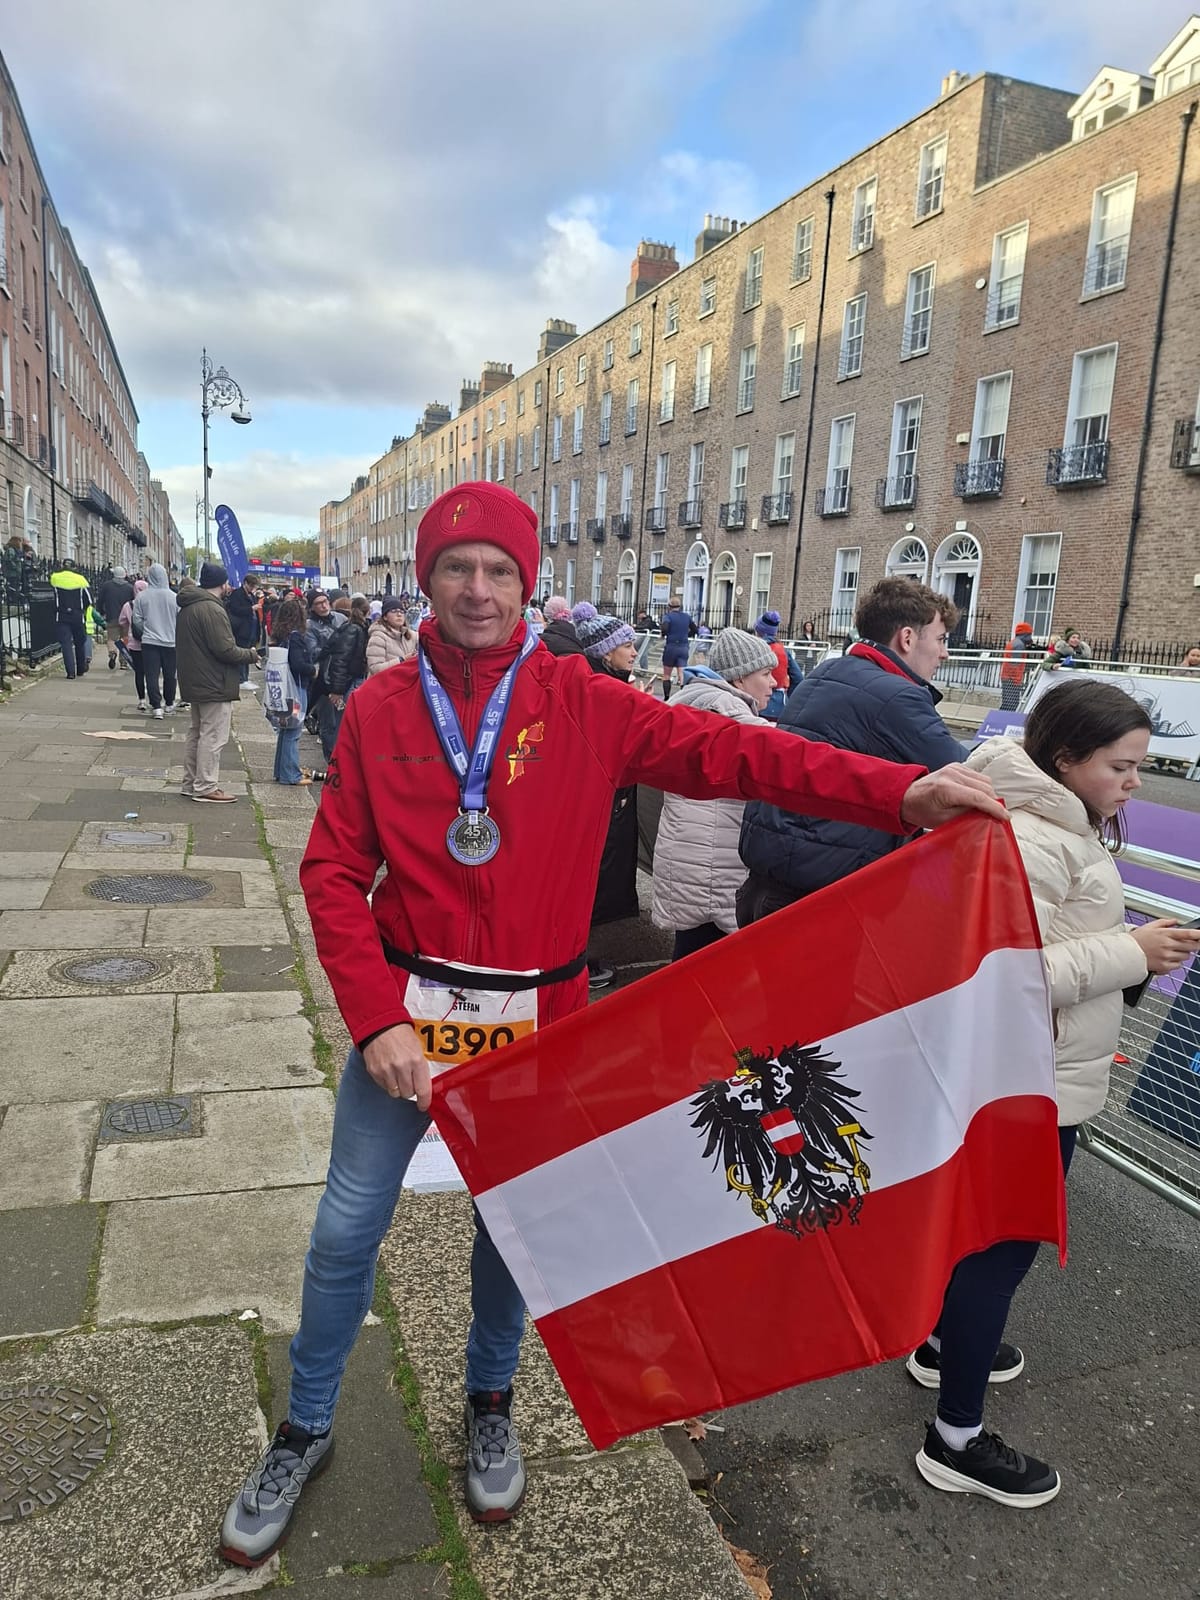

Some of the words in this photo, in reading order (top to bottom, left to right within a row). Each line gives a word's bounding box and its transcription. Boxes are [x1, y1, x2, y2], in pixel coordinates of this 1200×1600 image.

[223, 525, 233, 541] Irish
[230, 541, 240, 556] Life
[498, 670, 513, 704] FINISHER
[431, 693, 447, 727] FINISHER
[464, 826, 481, 837] 45
[452, 1001, 480, 1013] STEFAN
[420, 1024, 515, 1056] 1390
[18, 1448, 107, 1516] DUBLIN
